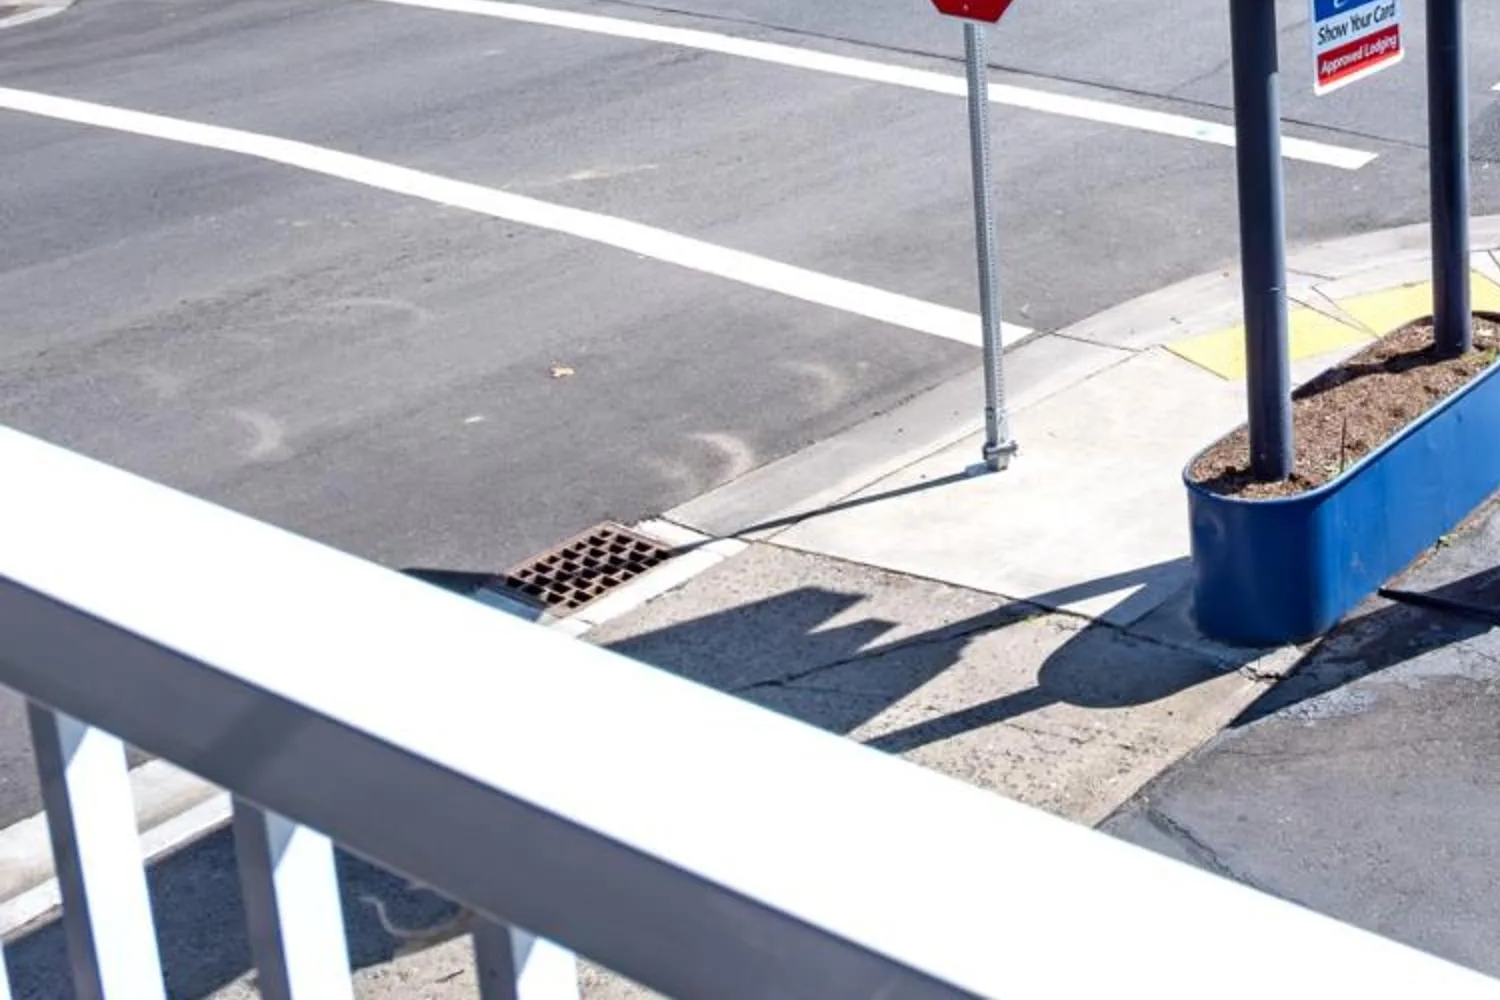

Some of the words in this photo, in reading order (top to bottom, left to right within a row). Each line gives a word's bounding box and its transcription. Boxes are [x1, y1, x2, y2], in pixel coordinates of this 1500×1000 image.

[1317, 20, 1348, 45] Show
[1350, 12, 1372, 33] Your
[1373, 0, 1396, 23] Card
[1320, 46, 1363, 75] Approved
[1363, 33, 1397, 58] Lodging
